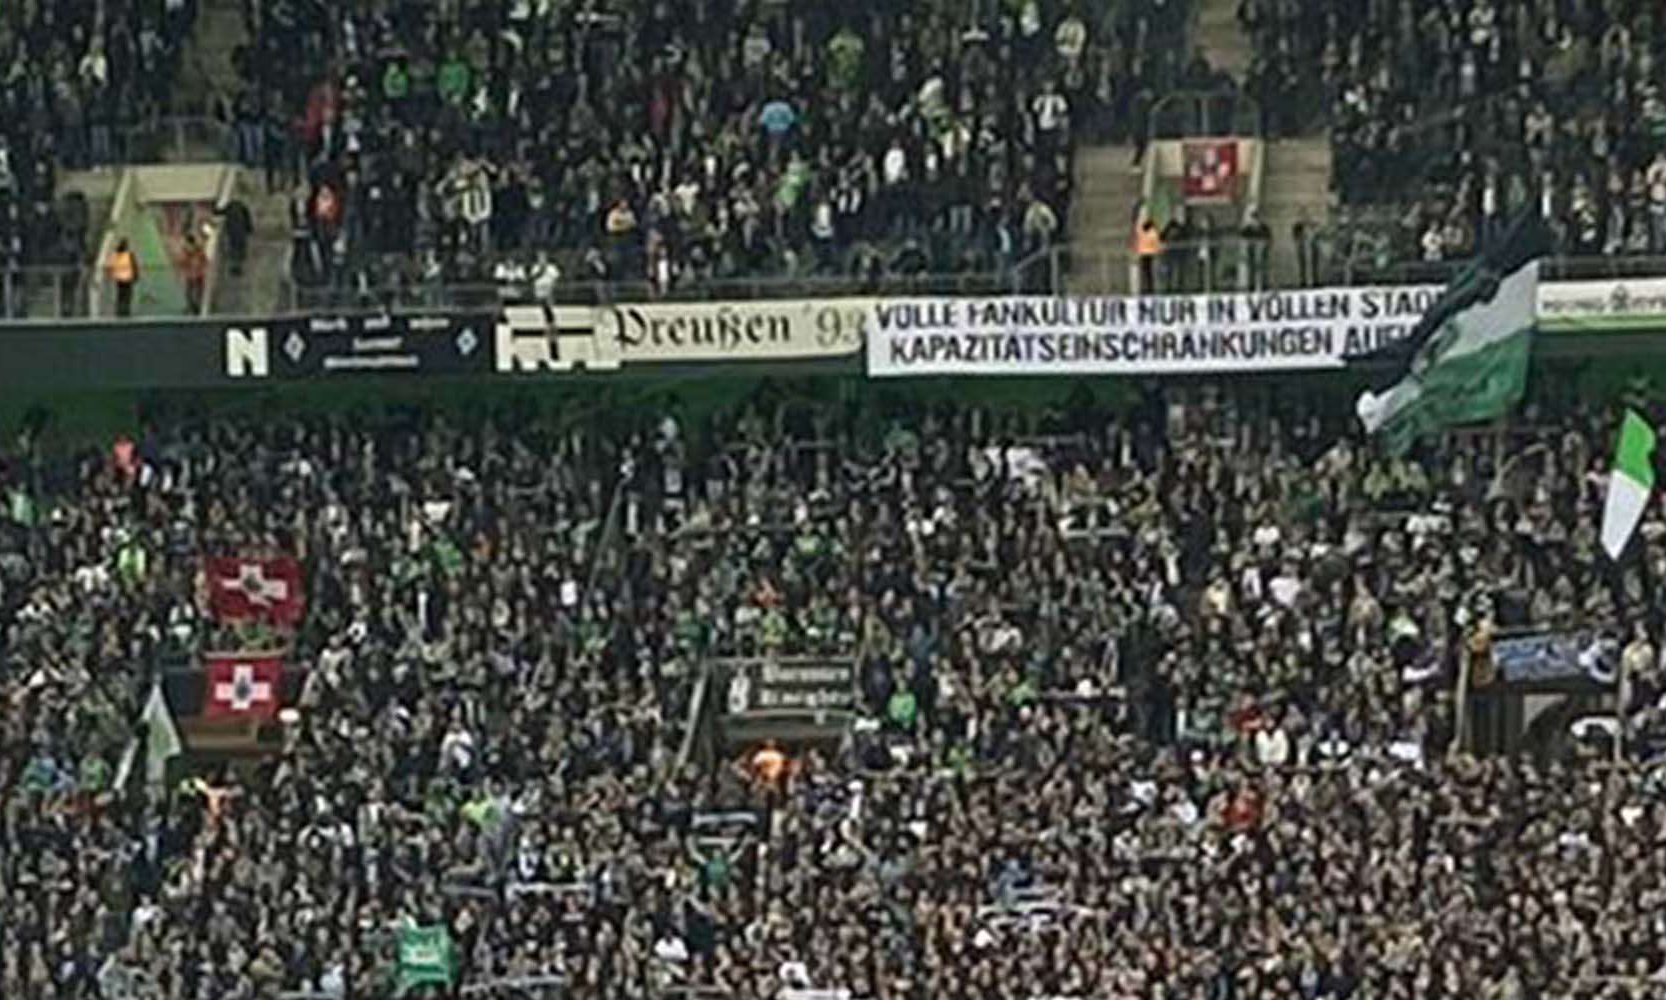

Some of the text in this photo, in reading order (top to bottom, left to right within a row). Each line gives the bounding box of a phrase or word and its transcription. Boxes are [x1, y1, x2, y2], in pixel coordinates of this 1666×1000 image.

[876, 303, 957, 330] VOLLE
[968, 299, 1126, 327] FANKULTUR
[1139, 299, 1196, 325] NUR
[1207, 298, 1233, 322] IN
[1247, 291, 1350, 321] VOLLEN
[226, 328, 268, 376] N
